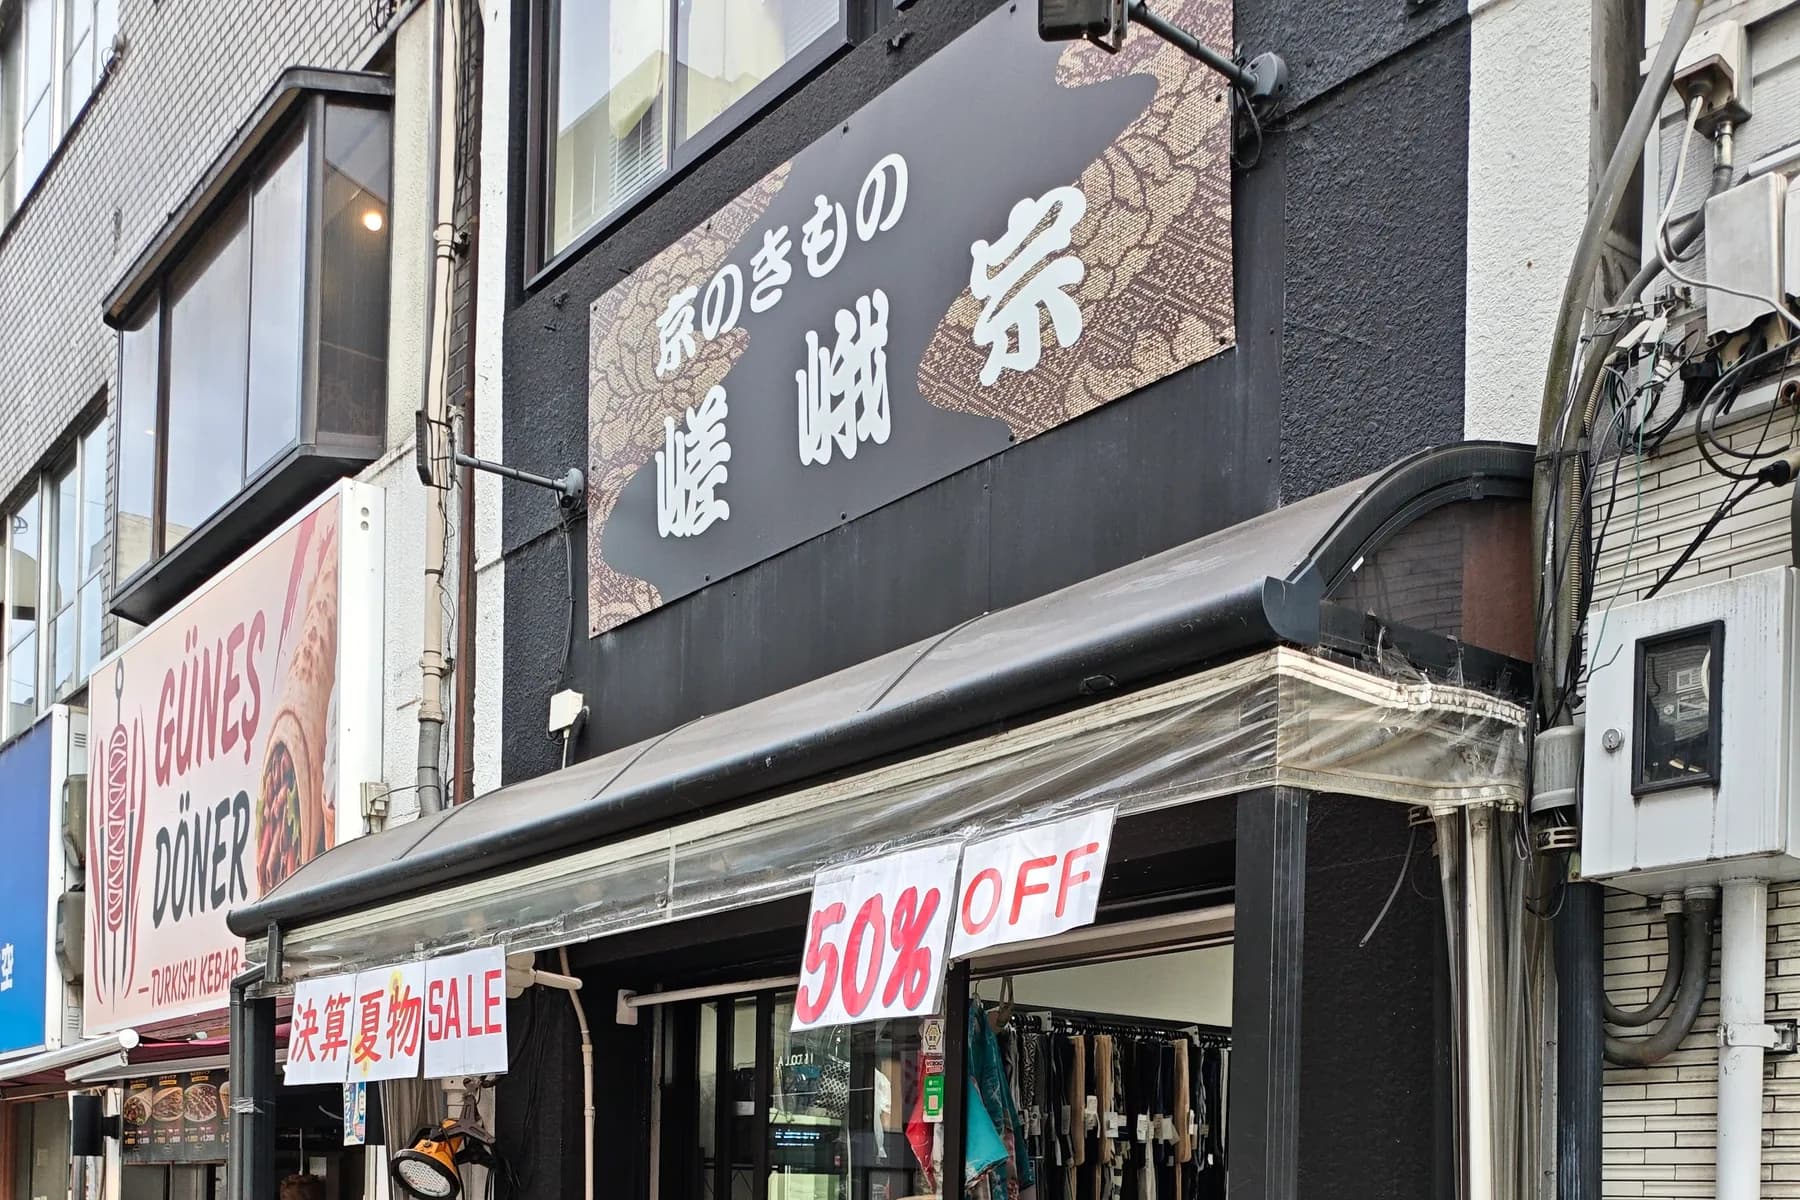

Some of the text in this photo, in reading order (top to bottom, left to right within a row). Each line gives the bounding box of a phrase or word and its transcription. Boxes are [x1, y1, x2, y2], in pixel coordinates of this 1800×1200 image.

[656, 153, 908, 377] 京のきもの
[153, 790, 250, 929] DÖNER
[152, 946, 239, 1007] TURKISH KEBAB
[796, 842, 1099, 1025] 50% OFF
[291, 968, 502, 1065] 決算夏物 SALE
